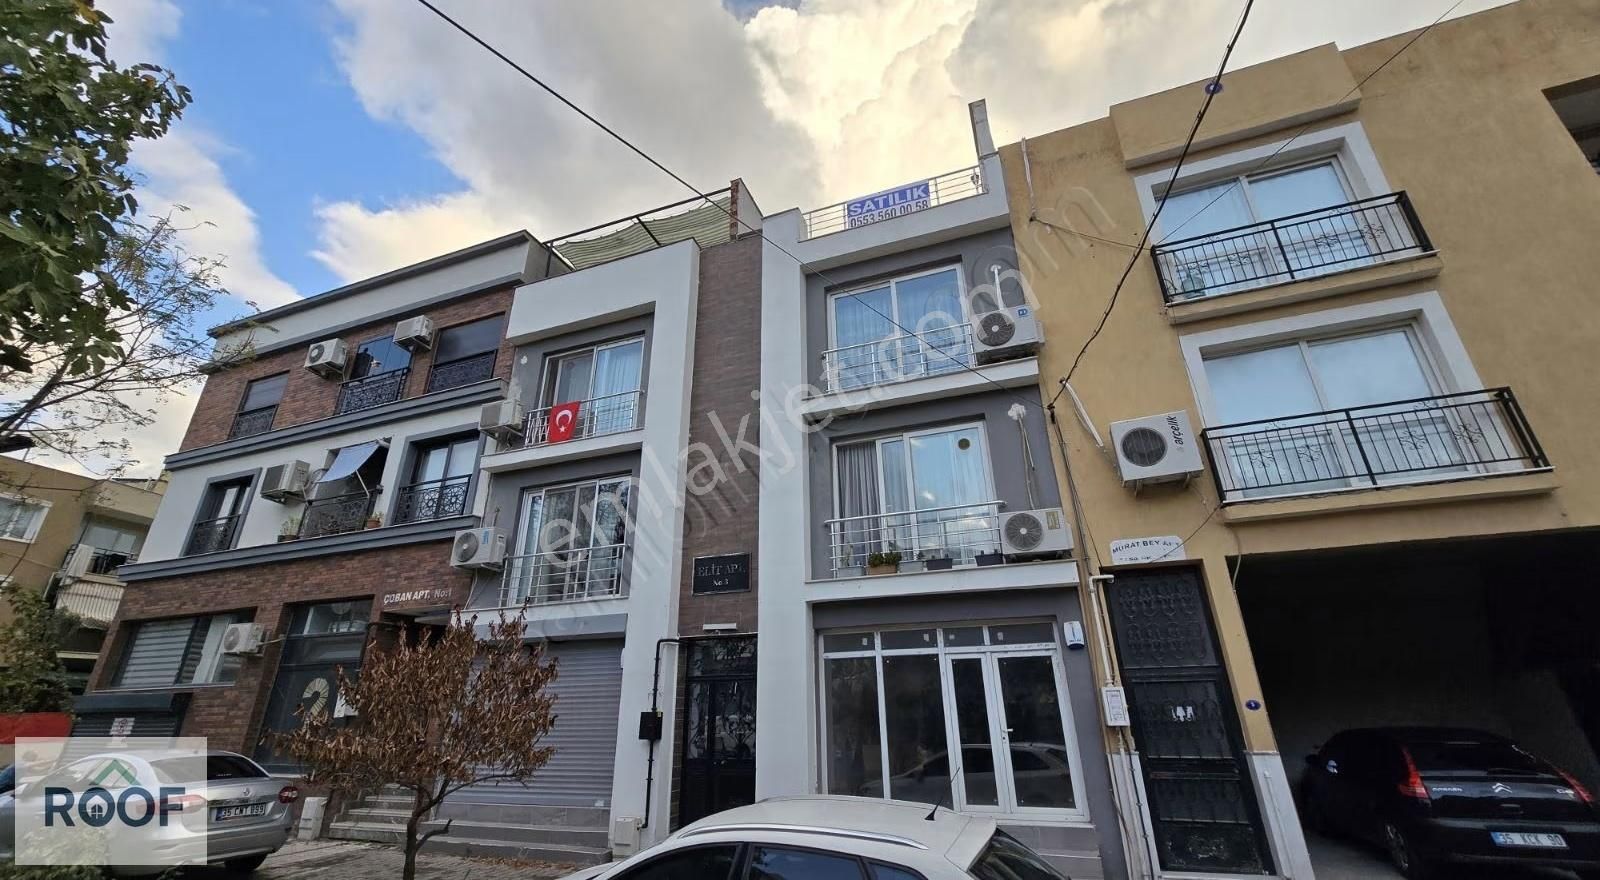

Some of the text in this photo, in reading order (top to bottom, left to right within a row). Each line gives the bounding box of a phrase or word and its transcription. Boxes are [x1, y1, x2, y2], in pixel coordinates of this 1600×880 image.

[849, 185, 927, 216] SATILIK
[850, 199, 929, 228] 0553 560 00 58
[1112, 541, 1140, 554] MURAT
[383, 591, 412, 606] ÇOBAN
[412, 589, 431, 600] APT.
